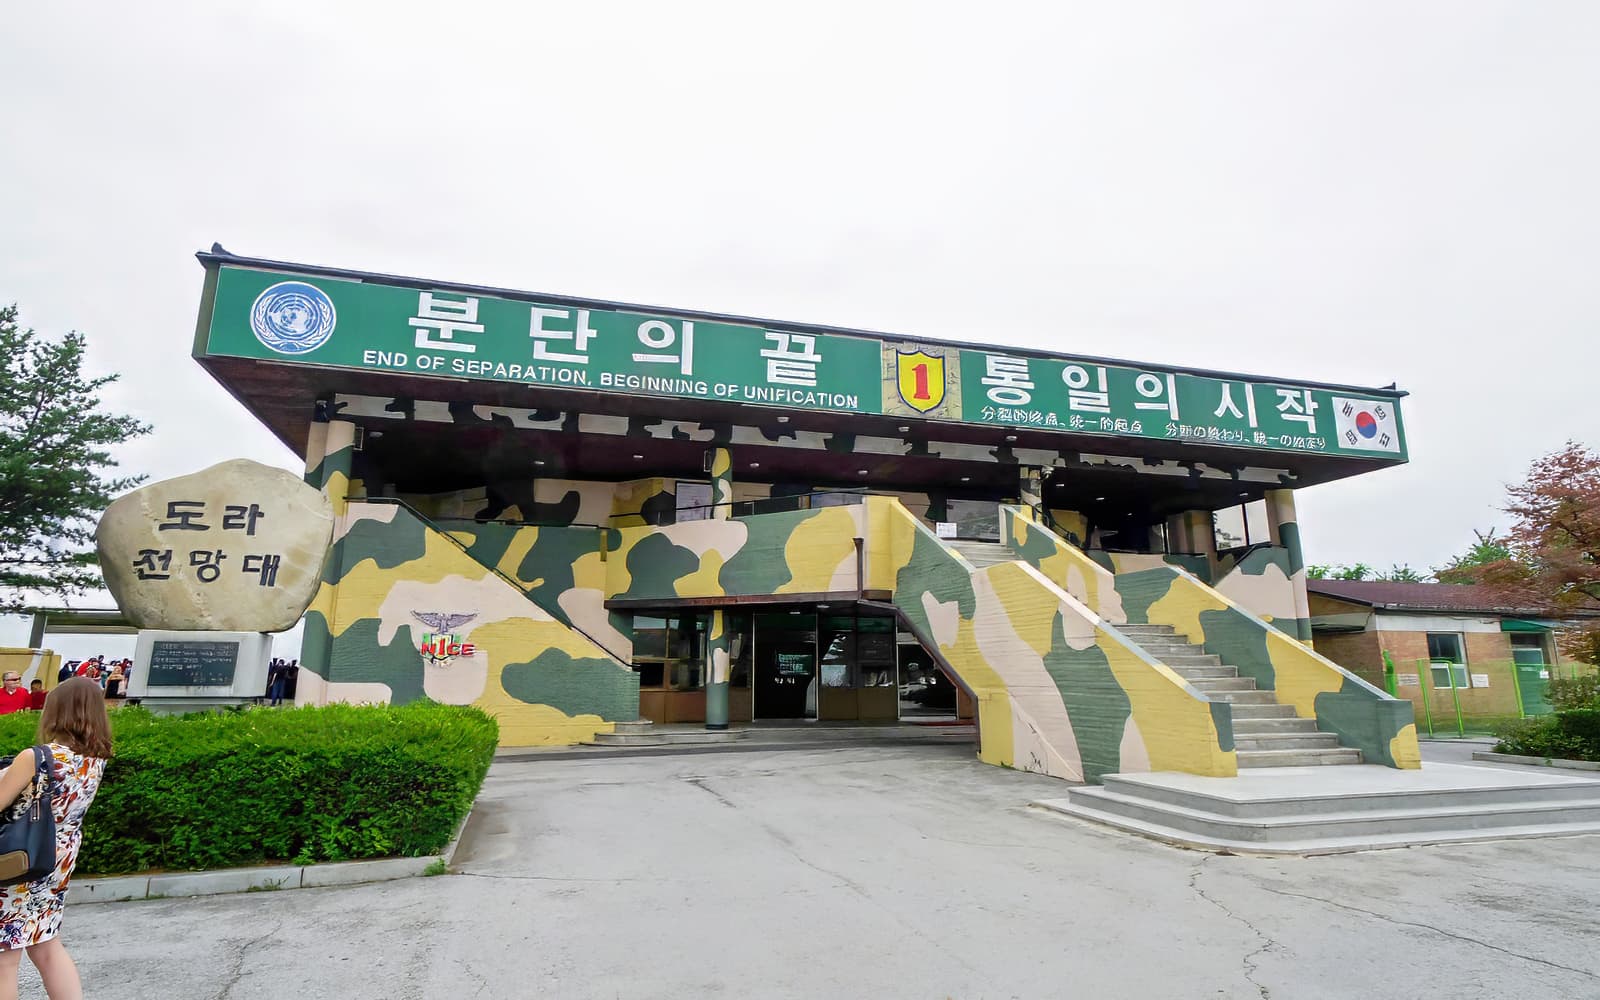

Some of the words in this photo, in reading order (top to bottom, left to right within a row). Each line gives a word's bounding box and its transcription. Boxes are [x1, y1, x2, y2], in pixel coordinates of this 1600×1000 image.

[759, 331, 822, 387] 끝
[363, 350, 408, 367] END
[416, 355, 445, 370] OF
[599, 372, 708, 395] BEGINNING
[713, 383, 739, 398] OF
[744, 386, 859, 409] UNIFICATION
[159, 500, 264, 536] 도라
[133, 549, 281, 587] 전망대
[421, 640, 475, 657] NICE
